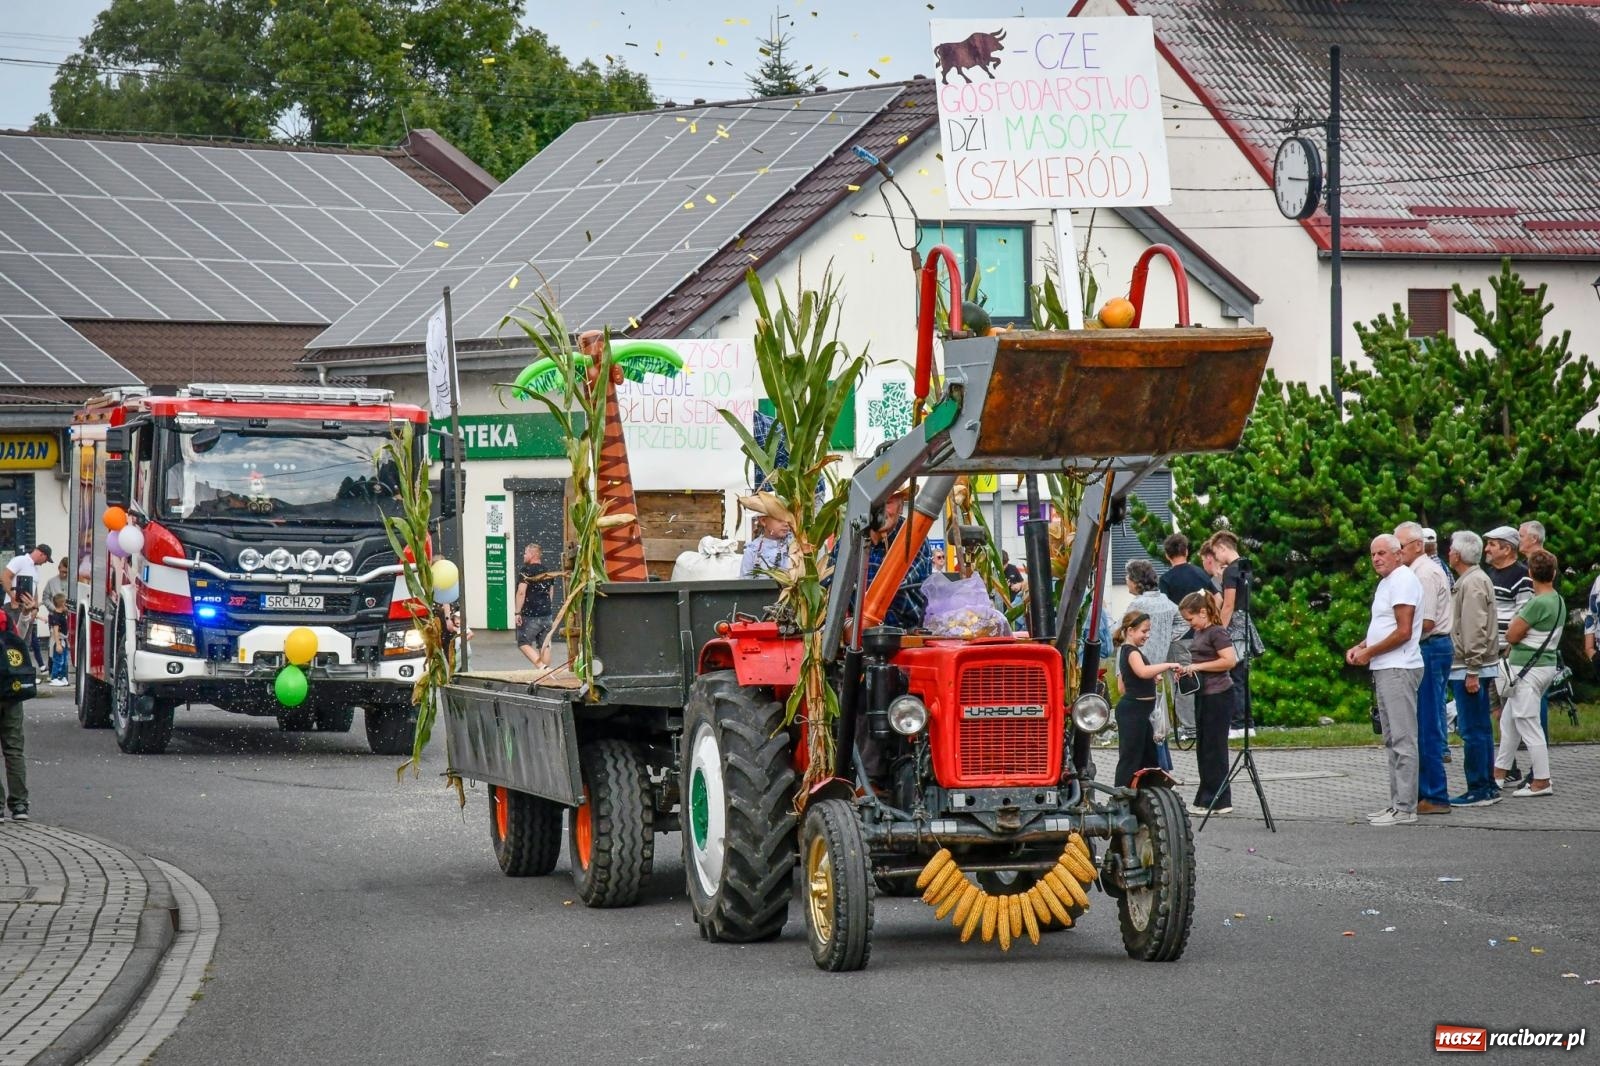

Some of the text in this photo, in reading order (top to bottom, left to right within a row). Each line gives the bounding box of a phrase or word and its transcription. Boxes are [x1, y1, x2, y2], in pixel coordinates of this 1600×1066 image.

[940, 74, 1150, 113] GOSPODARSTWO
[1004, 113, 1133, 151] MASORZ
[955, 150, 1149, 206] (SZKIERÓD)
[703, 371, 732, 398] DO
[0, 441, 49, 460] ATAN
[267, 596, 289, 608] SRC
[293, 596, 322, 608] HA29
[969, 706, 1039, 716] URSUS
